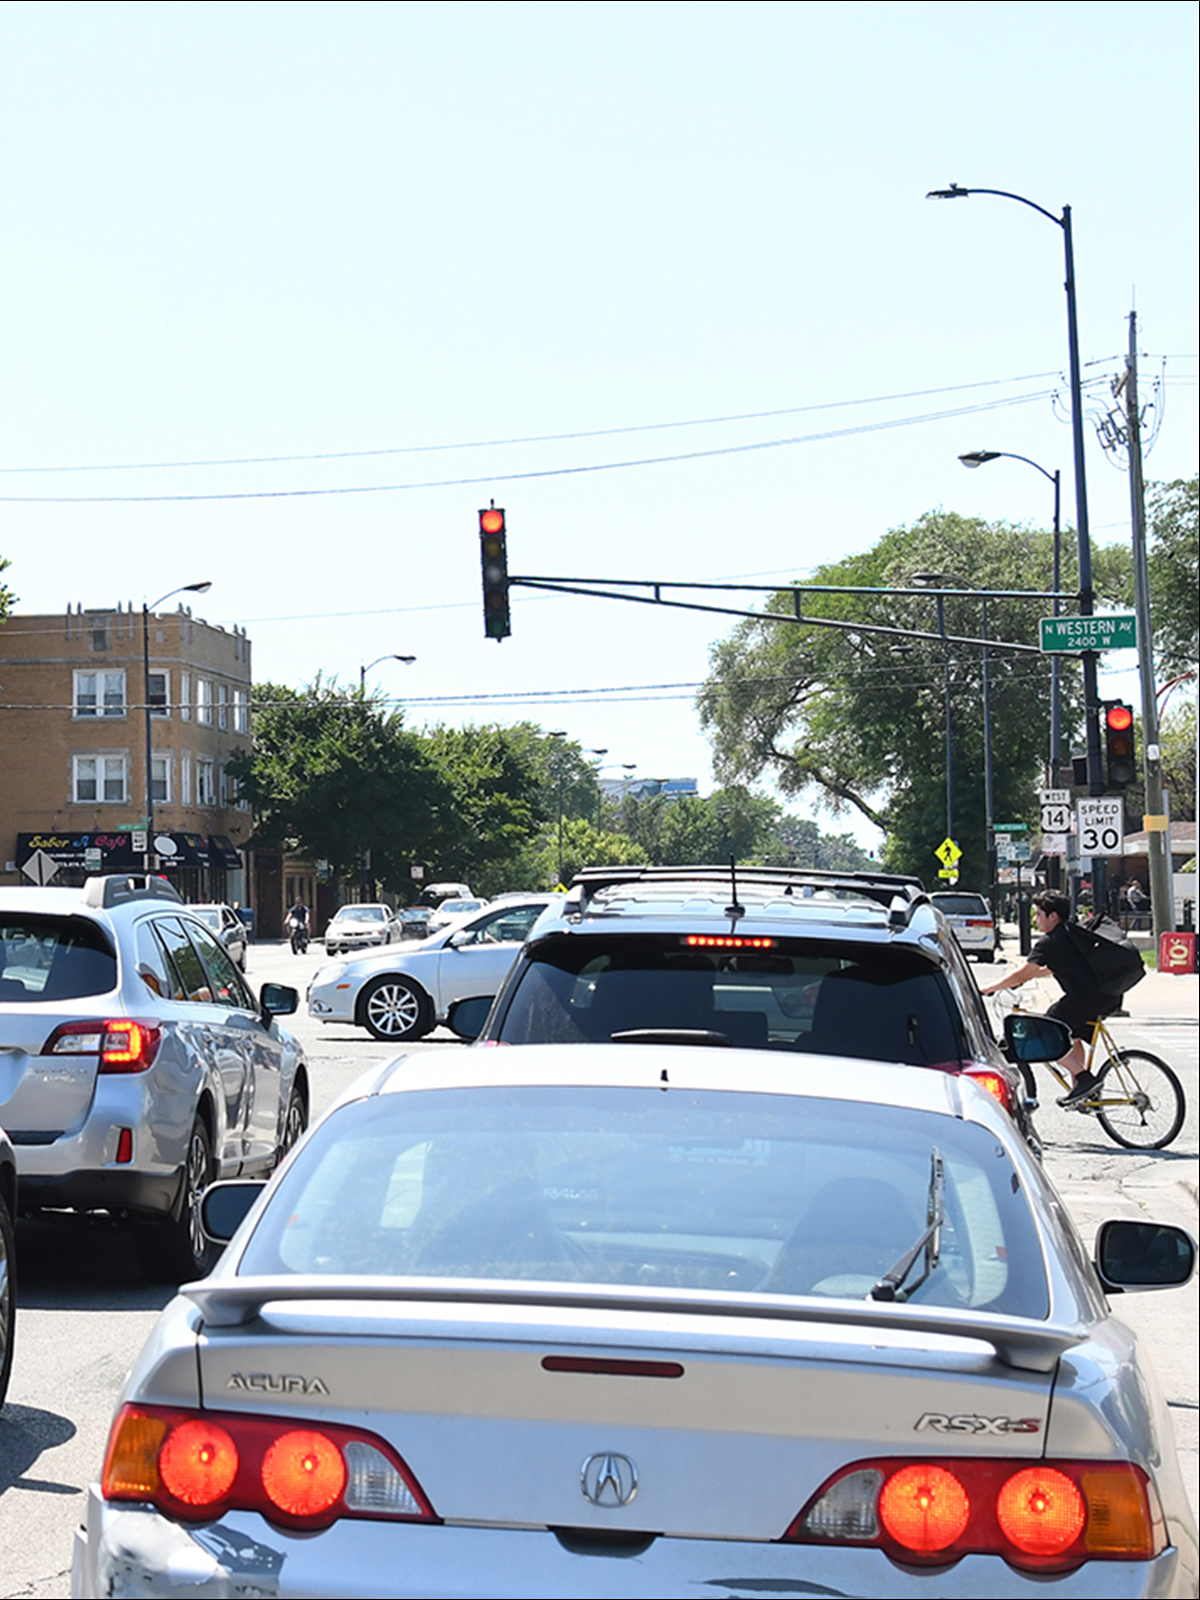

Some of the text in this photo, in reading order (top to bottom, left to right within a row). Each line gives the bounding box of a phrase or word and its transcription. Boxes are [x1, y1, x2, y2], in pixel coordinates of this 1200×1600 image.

[1045, 625, 1053, 634] N
[1056, 621, 1116, 635] WESTERN
[1068, 636, 1111, 647] 2400 W
[1045, 792, 1066, 801] WEST
[1081, 804, 1119, 815] SPEED
[1047, 810, 1064, 826] 14
[1085, 816, 1114, 826] LIMIT
[28, 835, 70, 849] Sabor
[94, 835, 128, 851] Café
[1083, 828, 1119, 850] 30
[226, 1372, 330, 1395] ACURA
